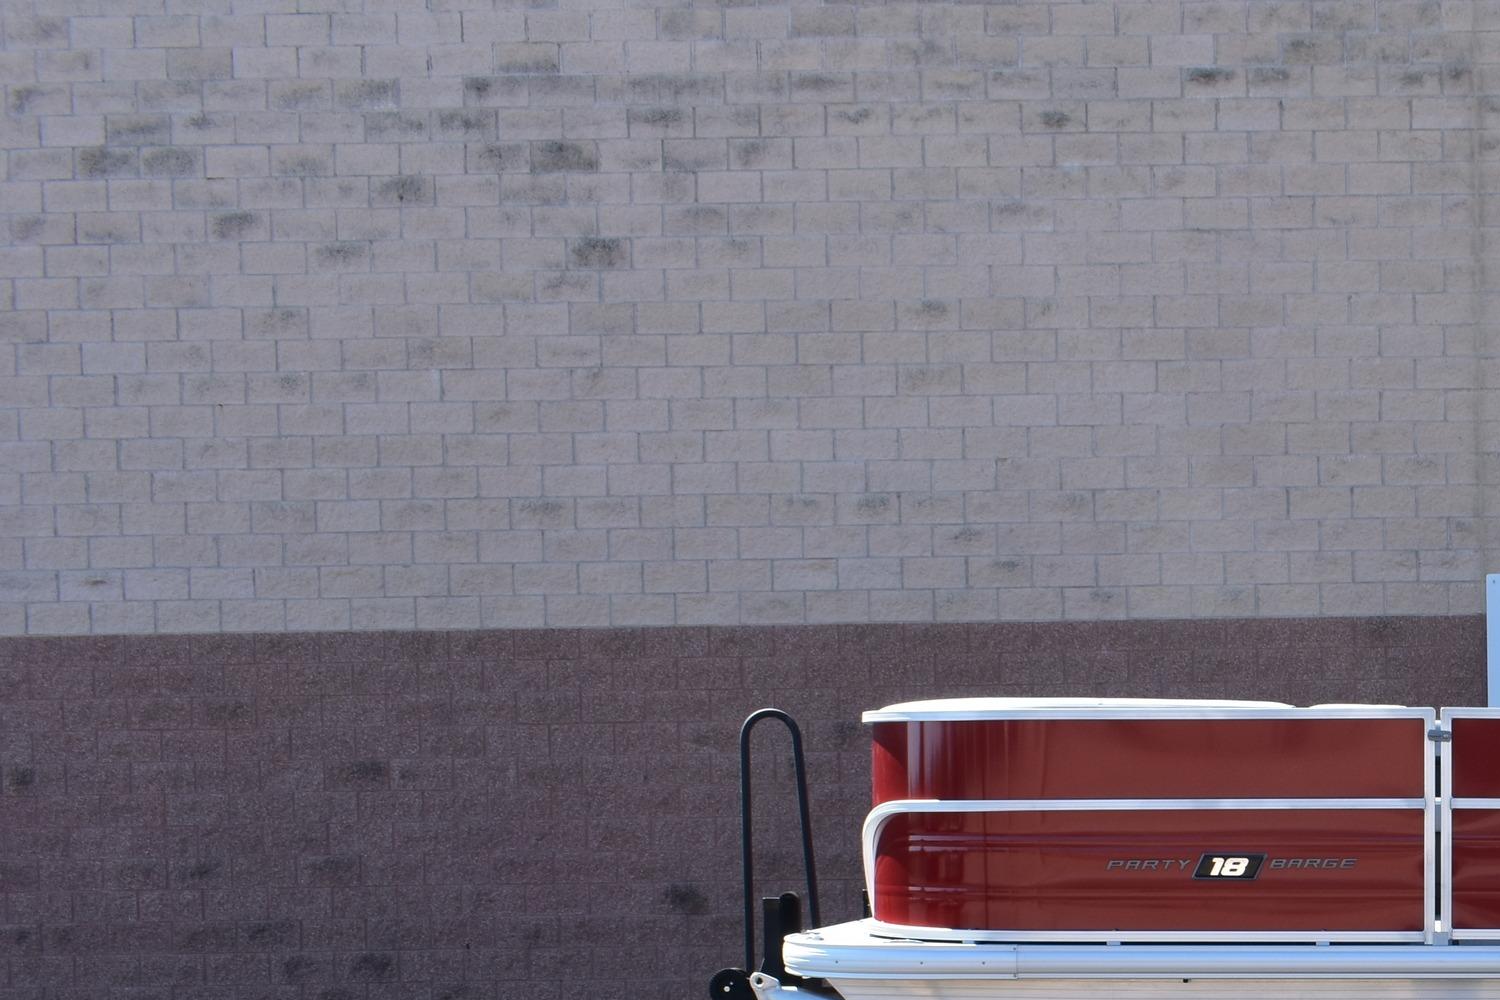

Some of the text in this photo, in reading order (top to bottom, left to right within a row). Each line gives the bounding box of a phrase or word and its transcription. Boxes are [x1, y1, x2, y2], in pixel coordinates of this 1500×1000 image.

[1106, 857, 1358, 876] PARTY 18 BARGE
